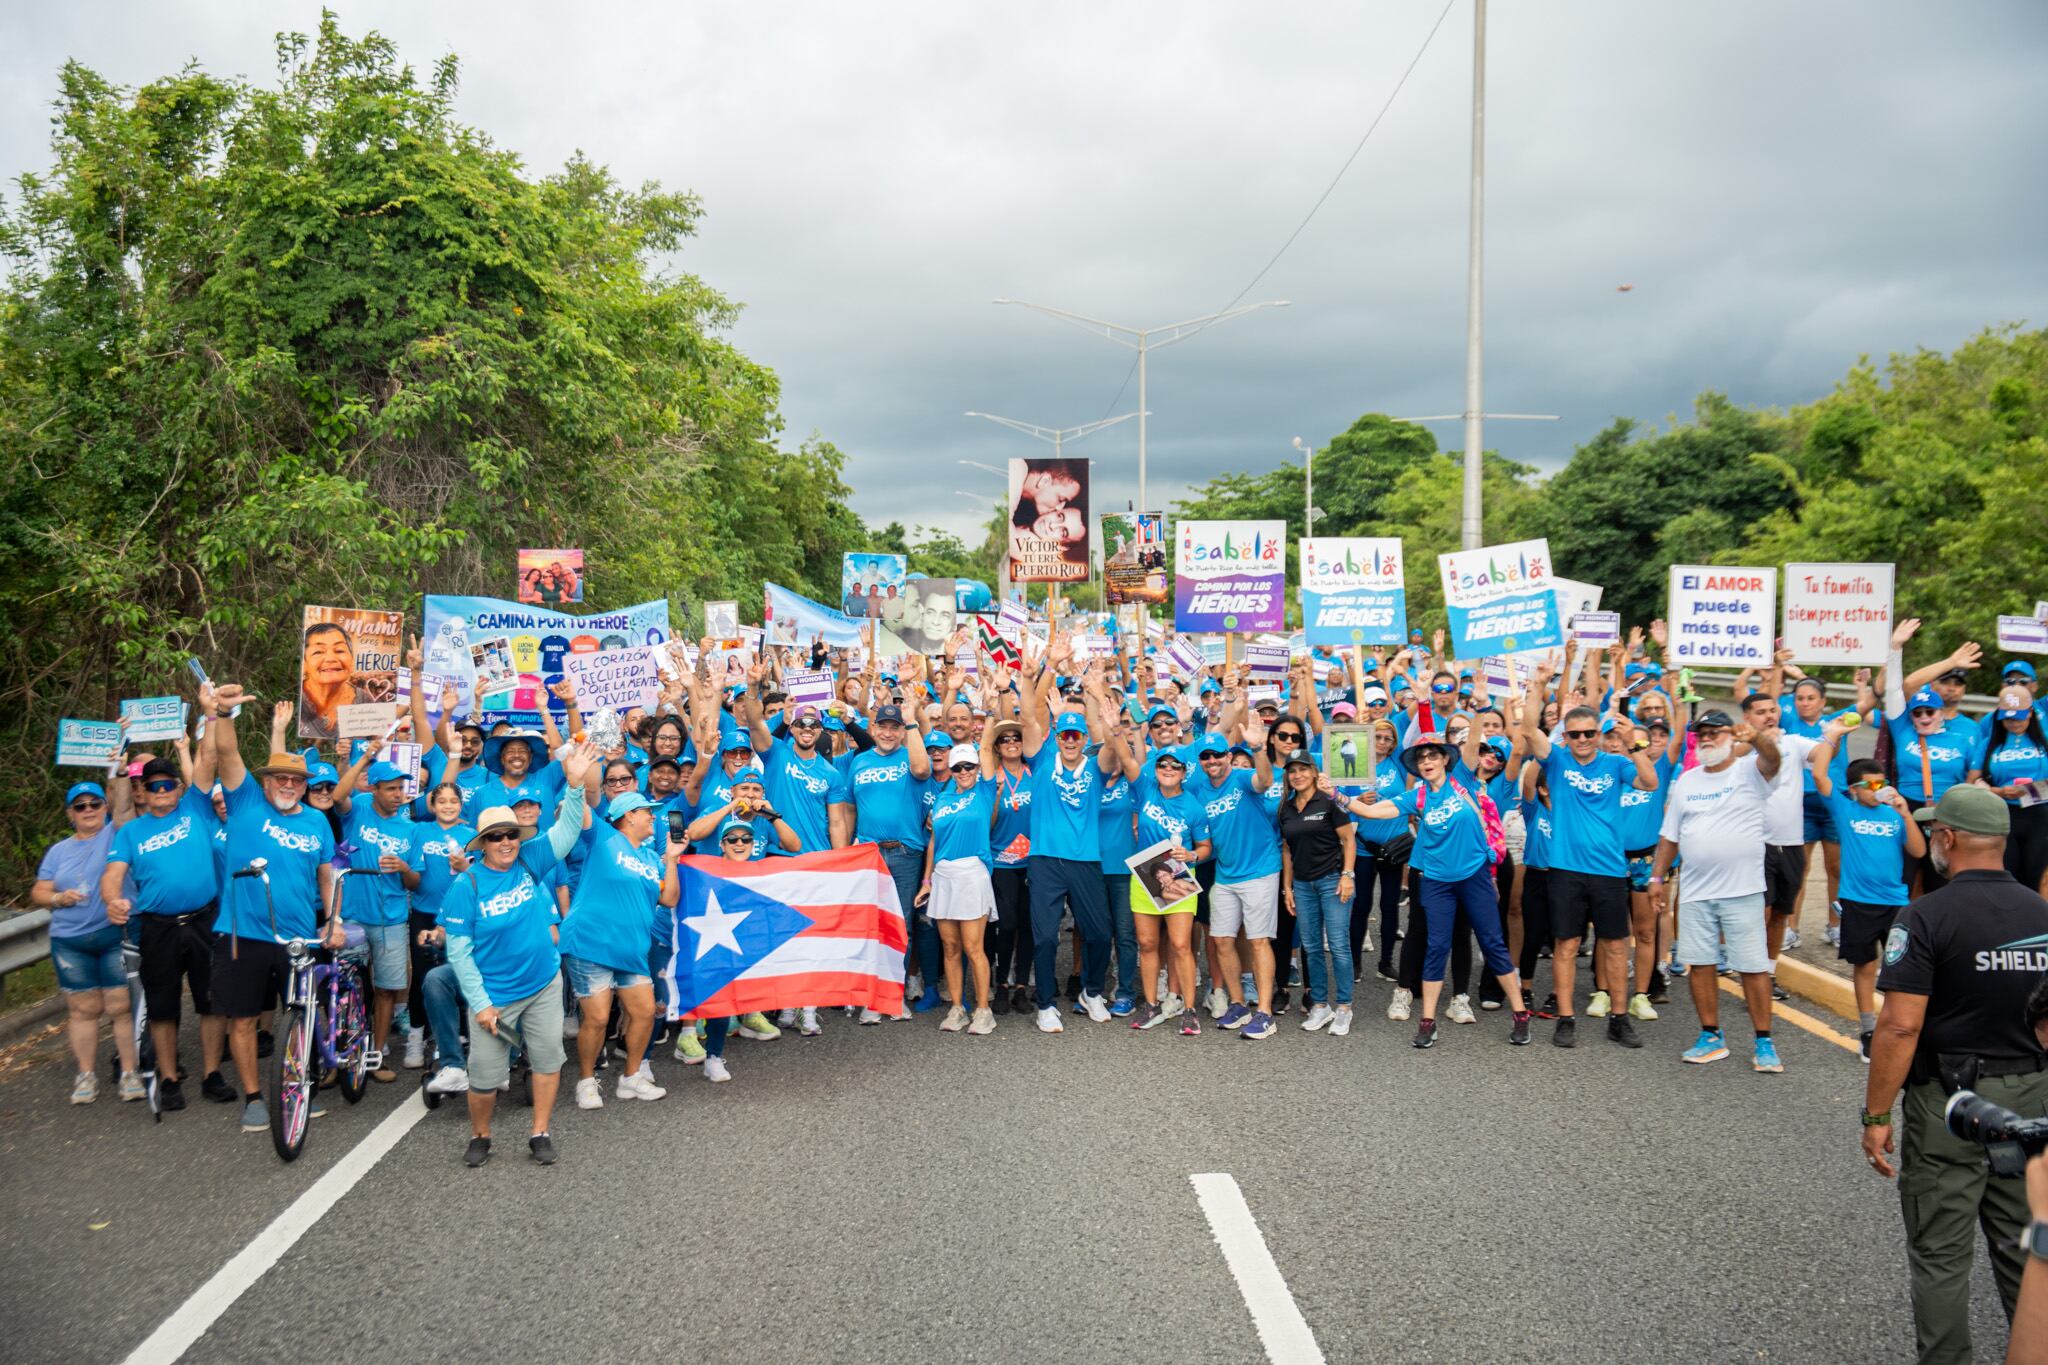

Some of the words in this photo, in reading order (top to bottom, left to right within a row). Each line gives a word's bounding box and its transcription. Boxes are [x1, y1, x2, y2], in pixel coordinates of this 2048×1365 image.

[1038, 554, 1062, 563] ERES
[1014, 564, 1057, 577] PUERTO
[1060, 564, 1087, 577] RICO
[1194, 582, 1232, 592] CAMINA
[1233, 582, 1254, 592] POR
[1253, 582, 1273, 591] LOS
[1682, 575, 1699, 590] El
[1705, 576, 1763, 591] AMOR
[1804, 575, 1819, 594] Tu
[1823, 575, 1873, 594] familia
[1187, 591, 1272, 613] HÉROES
[1356, 596, 1377, 605] POR
[1377, 596, 1394, 605] LOS
[1506, 602, 1526, 613] POR
[1526, 599, 1545, 609] LOS
[1693, 599, 1751, 615] puede
[478, 613, 535, 628] CAMINA
[538, 618, 566, 629] POR
[1315, 606, 1395, 627] HÉROES
[1788, 604, 1839, 625] siempre
[1843, 604, 1888, 622] estará
[344, 620, 400, 637] Mami
[1465, 611, 1547, 641] HÉROES
[1682, 620, 1720, 635] más
[1726, 622, 1760, 639] que
[360, 638, 379, 647] eres
[1678, 642, 1694, 655] el
[1700, 643, 1763, 658] olvido.
[1810, 631, 1863, 653] contigo.
[356, 652, 398, 672] HÉROE
[569, 660, 587, 673] EL
[593, 649, 651, 669] CORAZÓN
[582, 666, 645, 686] RECUERDA
[798, 675, 824, 684] HONOR
[589, 683, 609, 694] QUE
[614, 680, 626, 690] LA
[628, 677, 658, 687] MENTE
[595, 690, 641, 707] OLVIDA
[141, 702, 179, 715] CISS
[80, 726, 119, 741] CISS
[145, 719, 181, 731] HÉROE
[82, 743, 114, 755] HÉRO
[855, 769, 898, 785] HÉROE
[1620, 790, 1650, 807] ROE
[1206, 798, 1237, 818] ÉROE
[138, 826, 189, 854] HÉROE
[479, 884, 533, 918] HÉROE
[1975, 950, 2048, 972] SHIELD
